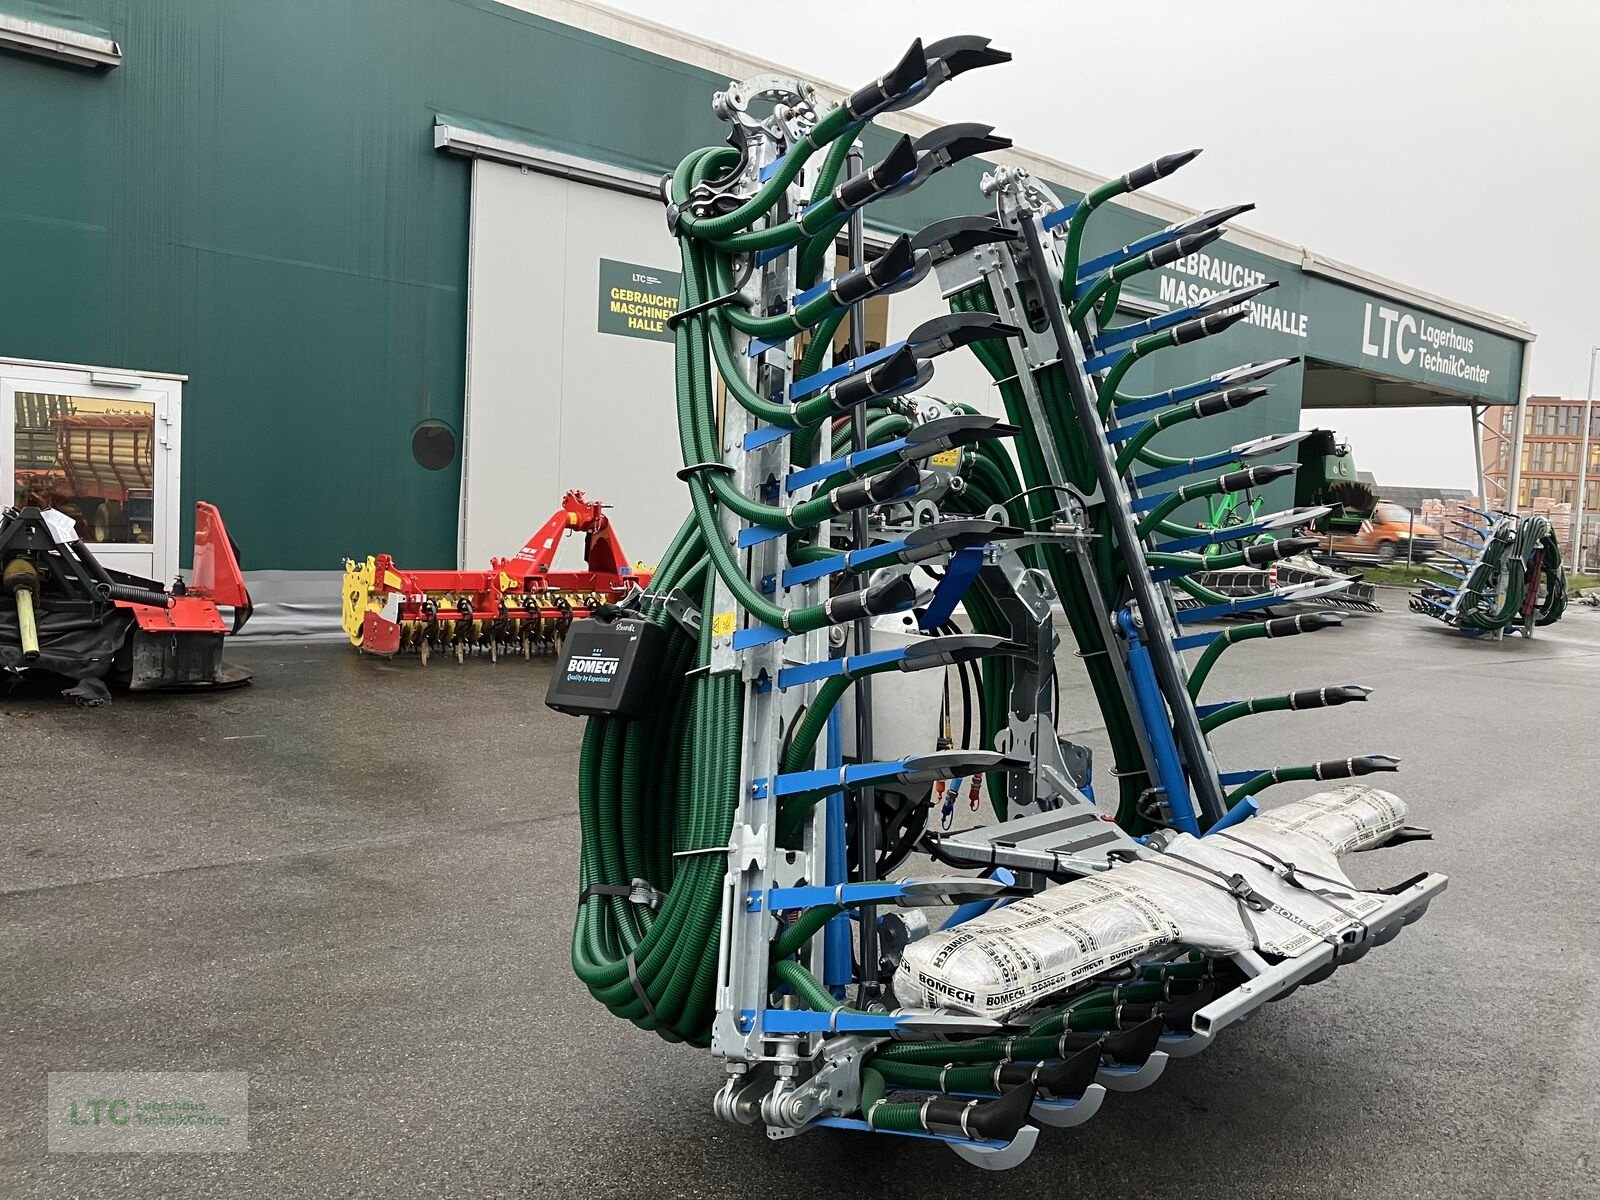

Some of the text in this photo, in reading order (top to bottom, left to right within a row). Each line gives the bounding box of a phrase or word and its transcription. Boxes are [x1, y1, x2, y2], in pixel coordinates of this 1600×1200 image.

[632, 273, 647, 283] LTC
[610, 287, 679, 309] GEBRAUCHT
[628, 317, 664, 333] HALLE
[1362, 302, 1417, 365] LTC
[1420, 319, 1474, 354] Lagerhaus
[1418, 346, 1490, 384] TechnikCenter
[567, 659, 619, 675] BOMECH
[933, 933, 974, 968] BOMECH
[919, 973, 975, 1004] BOMECH
[986, 988, 1026, 1006] BOMECH
